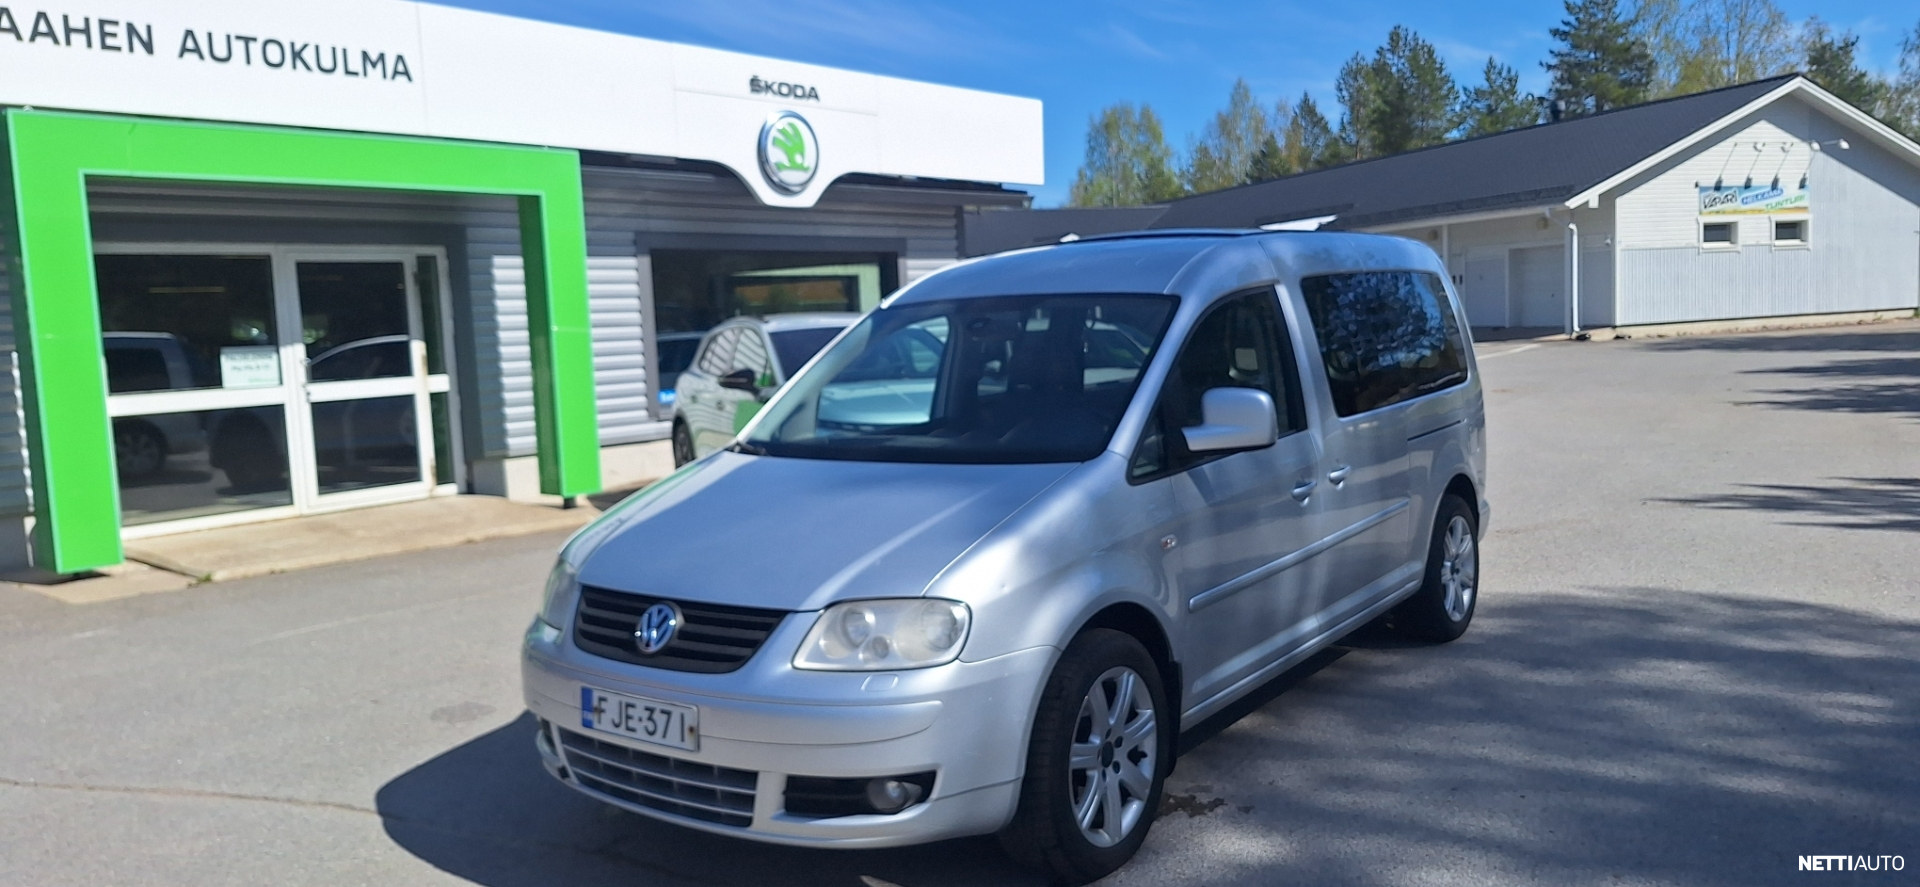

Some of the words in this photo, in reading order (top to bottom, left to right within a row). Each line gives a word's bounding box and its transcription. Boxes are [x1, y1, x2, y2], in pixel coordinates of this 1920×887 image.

[178, 29, 413, 82] AUTOKULMA
[749, 75, 820, 101] ŠKODA
[597, 695, 686, 743] FJE-371
